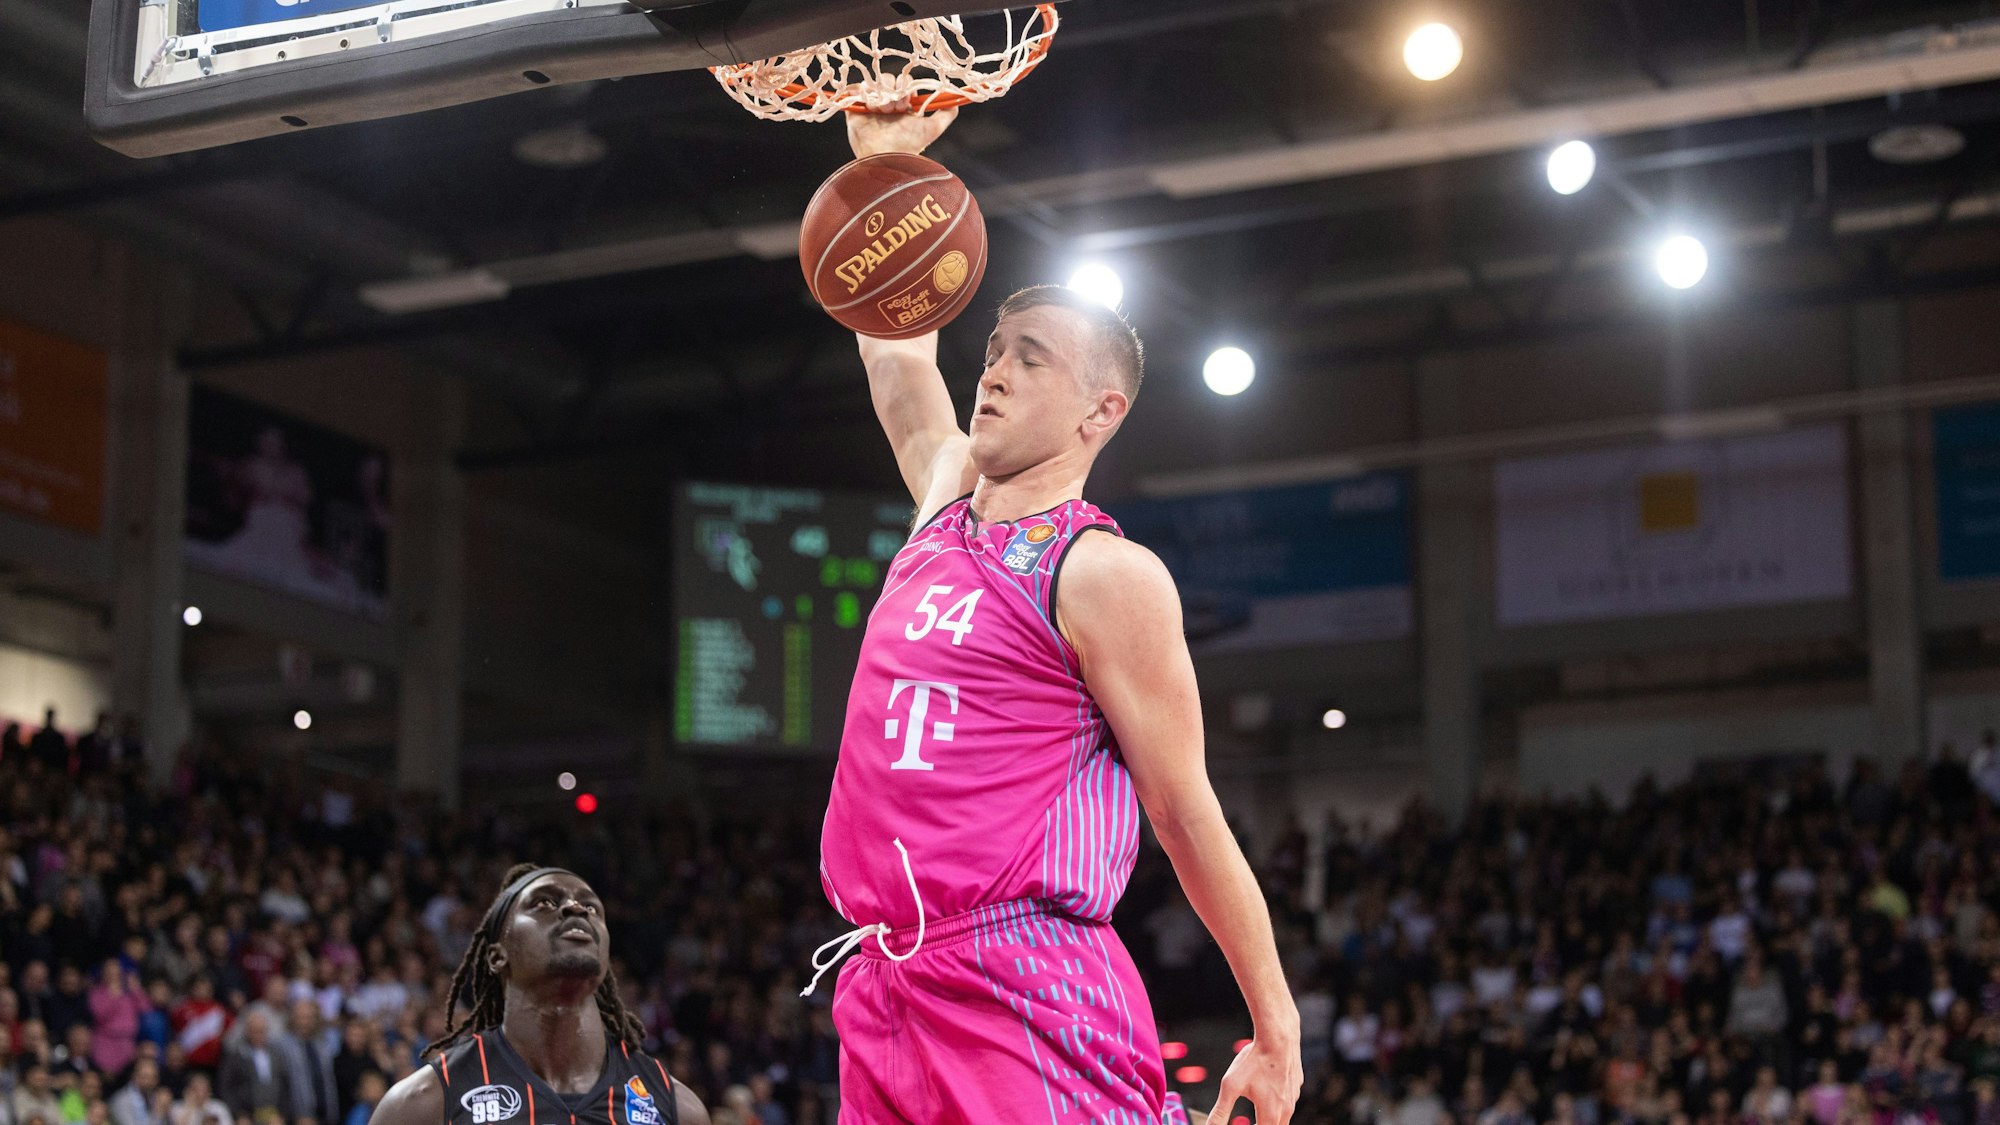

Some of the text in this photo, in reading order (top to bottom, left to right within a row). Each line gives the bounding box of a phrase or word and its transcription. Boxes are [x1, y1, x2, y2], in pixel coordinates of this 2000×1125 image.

[897, 298, 938, 325] BBL
[1003, 554, 1031, 570] BBL
[904, 584, 985, 646] 54
[884, 678, 959, 771] T
[472, 1100, 501, 1124] 99
[631, 1109, 660, 1125] BBL
